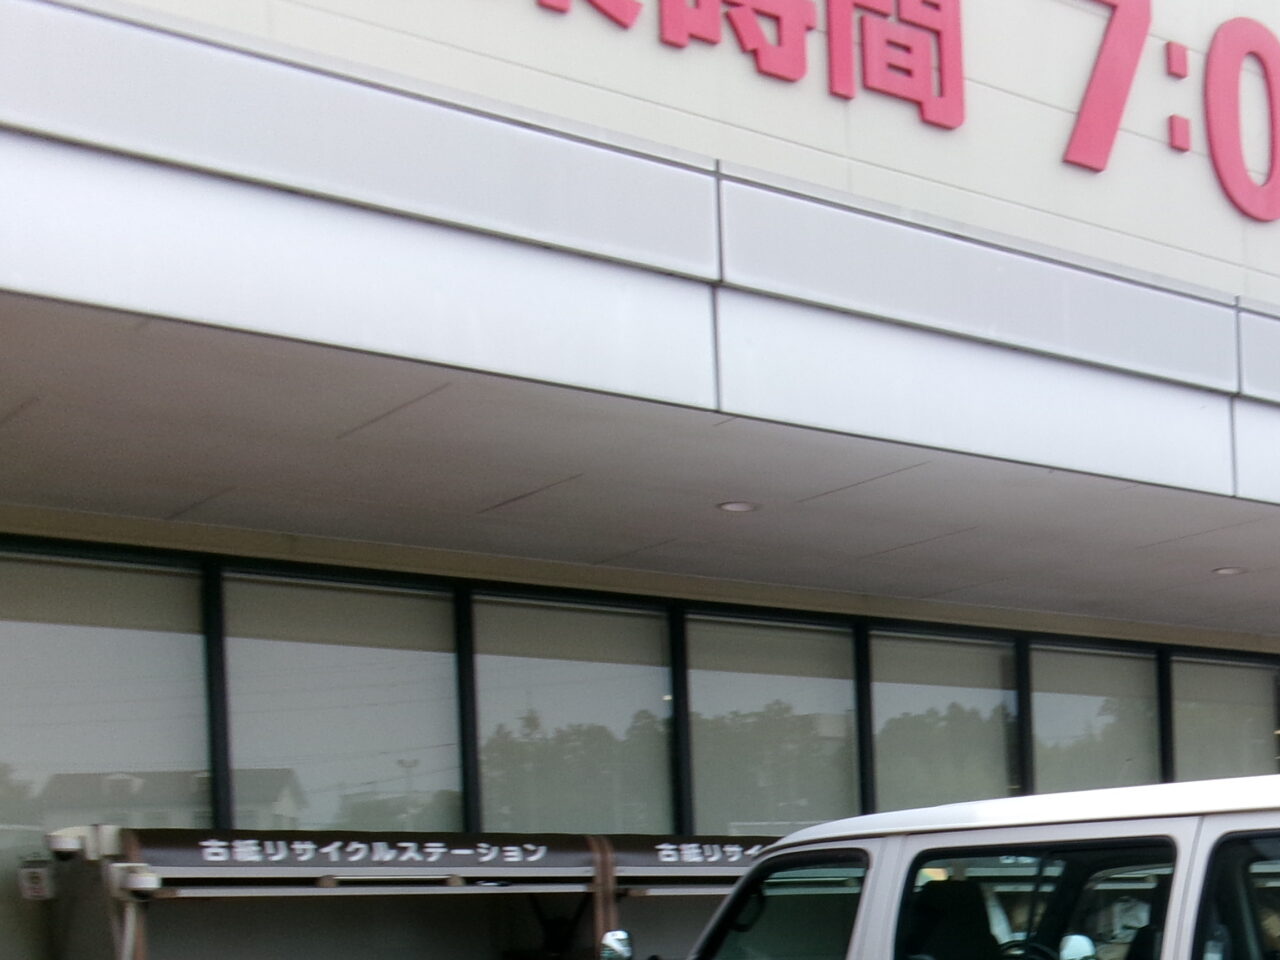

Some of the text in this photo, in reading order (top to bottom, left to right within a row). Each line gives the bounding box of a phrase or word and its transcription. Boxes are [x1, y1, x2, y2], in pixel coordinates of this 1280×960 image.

[199, 838, 548, 863] 古紙リサイクルステーション
